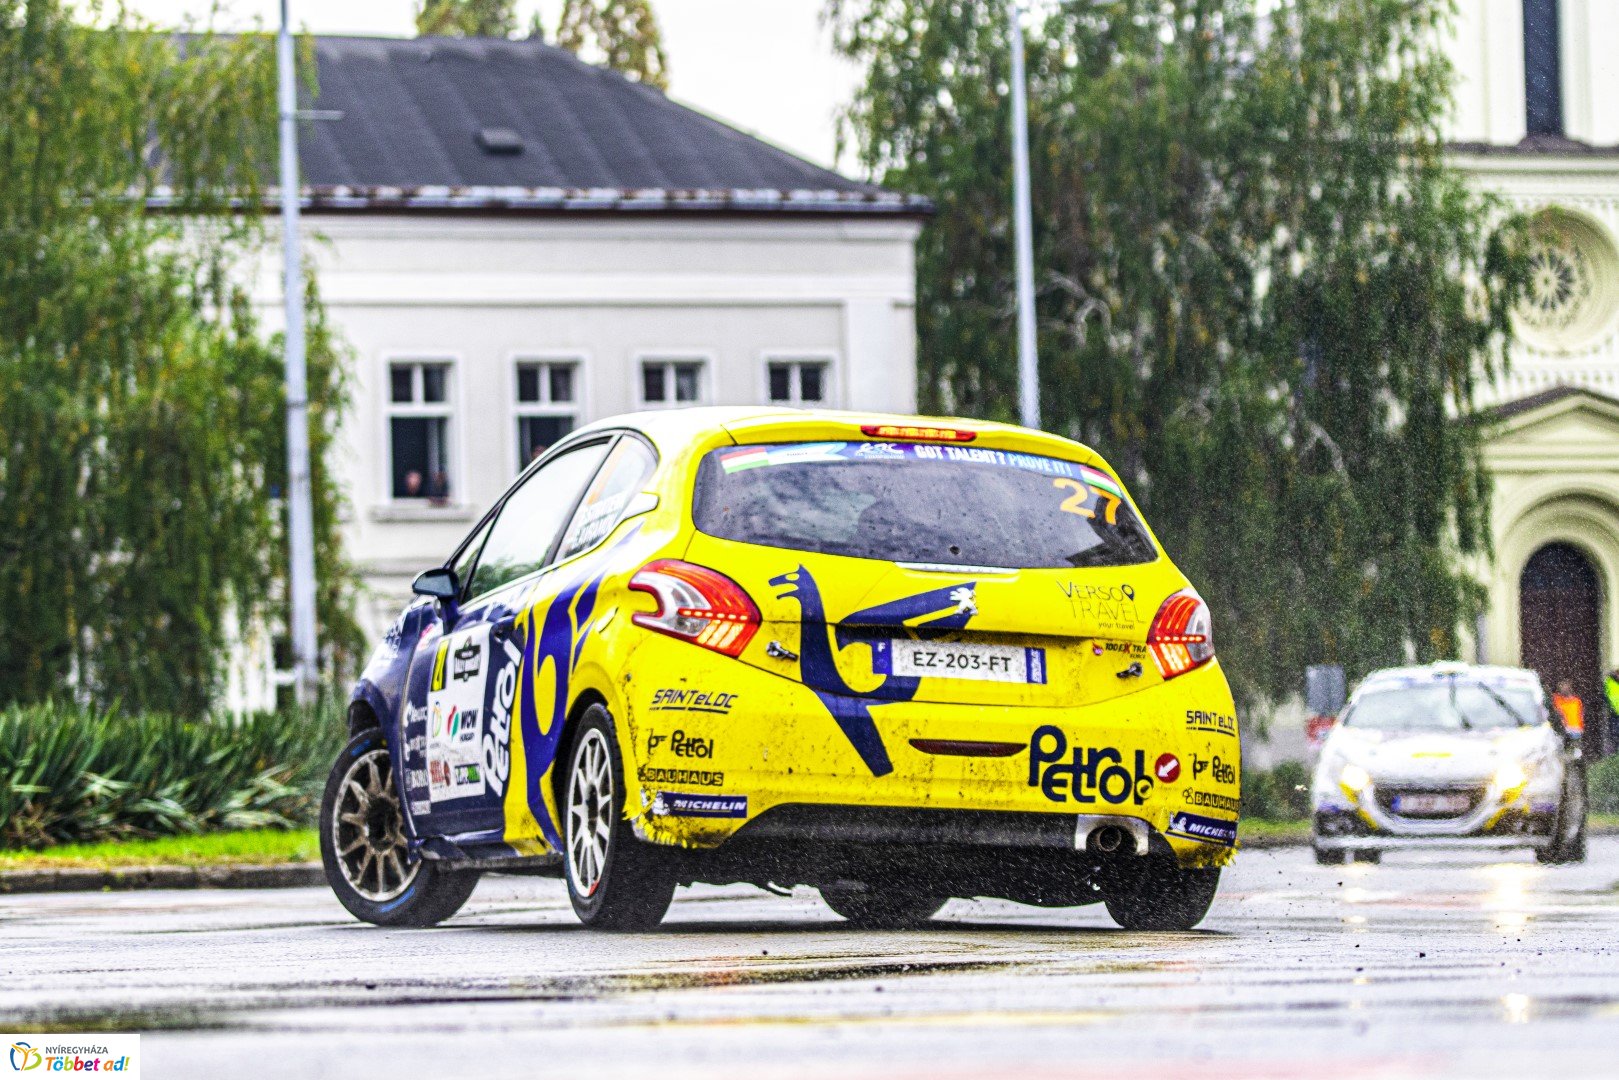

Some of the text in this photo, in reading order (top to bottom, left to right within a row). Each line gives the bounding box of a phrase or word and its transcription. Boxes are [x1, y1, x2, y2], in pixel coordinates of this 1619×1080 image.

[914, 445, 943, 459] GOT
[1006, 452, 1053, 472] PROVE
[1053, 478, 1122, 525] 27
[1069, 599, 1147, 624] TRAVEL
[877, 642, 886, 652] F
[912, 651, 1012, 672] EZ-203-FT
[671, 729, 714, 759] Petrol
[646, 768, 724, 786] BAUHAUS
[1028, 725, 1146, 806] Petrol
[1212, 755, 1236, 785] Petrol
[673, 799, 747, 811] MICHELIN
